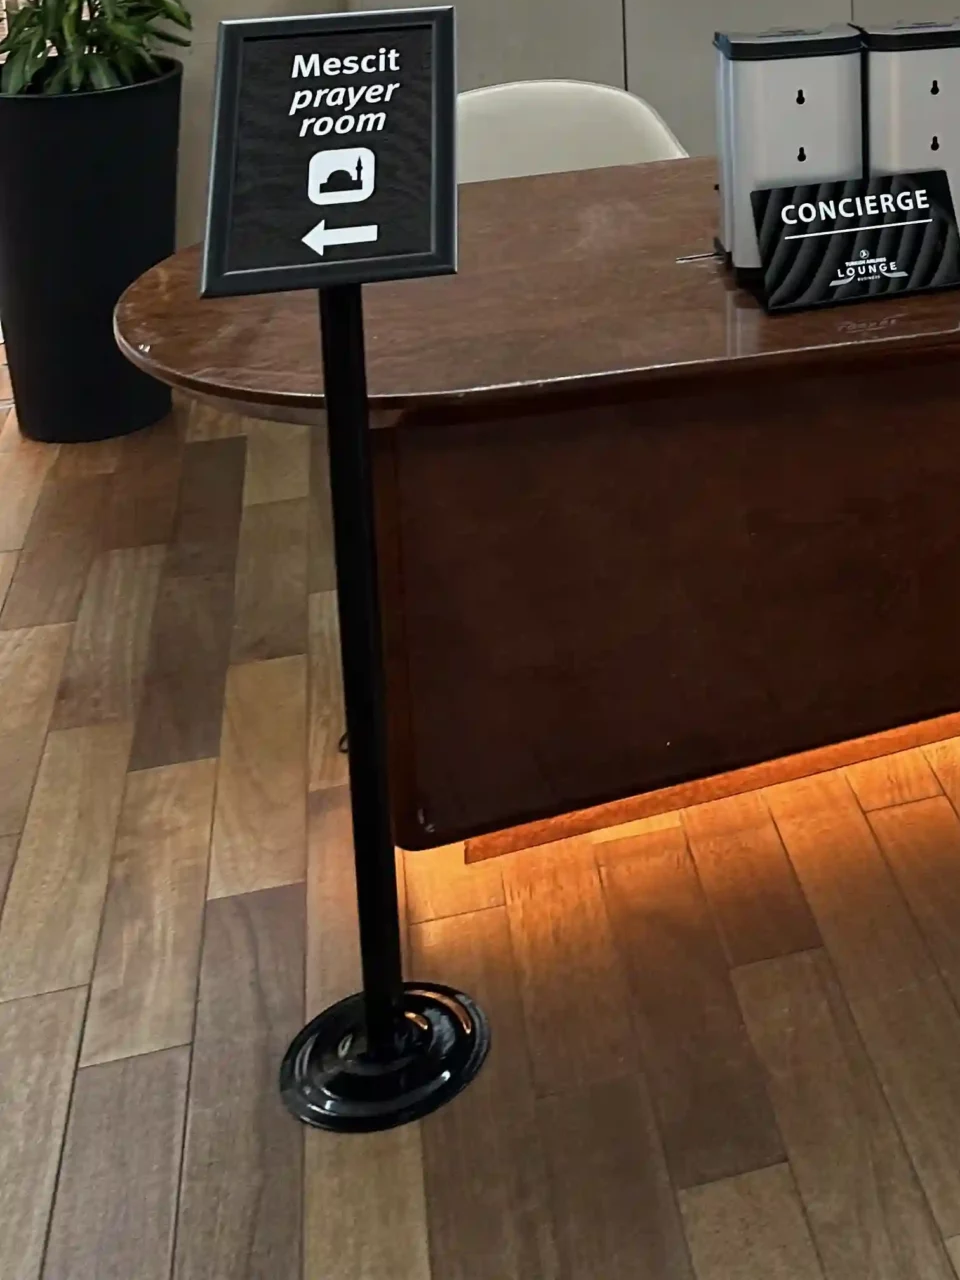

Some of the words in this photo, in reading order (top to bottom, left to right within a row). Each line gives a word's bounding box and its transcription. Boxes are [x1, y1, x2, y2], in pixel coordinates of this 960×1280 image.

[291, 48, 401, 79] Mescit
[289, 82, 401, 116] prayer
[299, 111, 387, 137] room
[781, 189, 930, 225] CONCIERGE
[837, 261, 898, 278] LOUNGE
